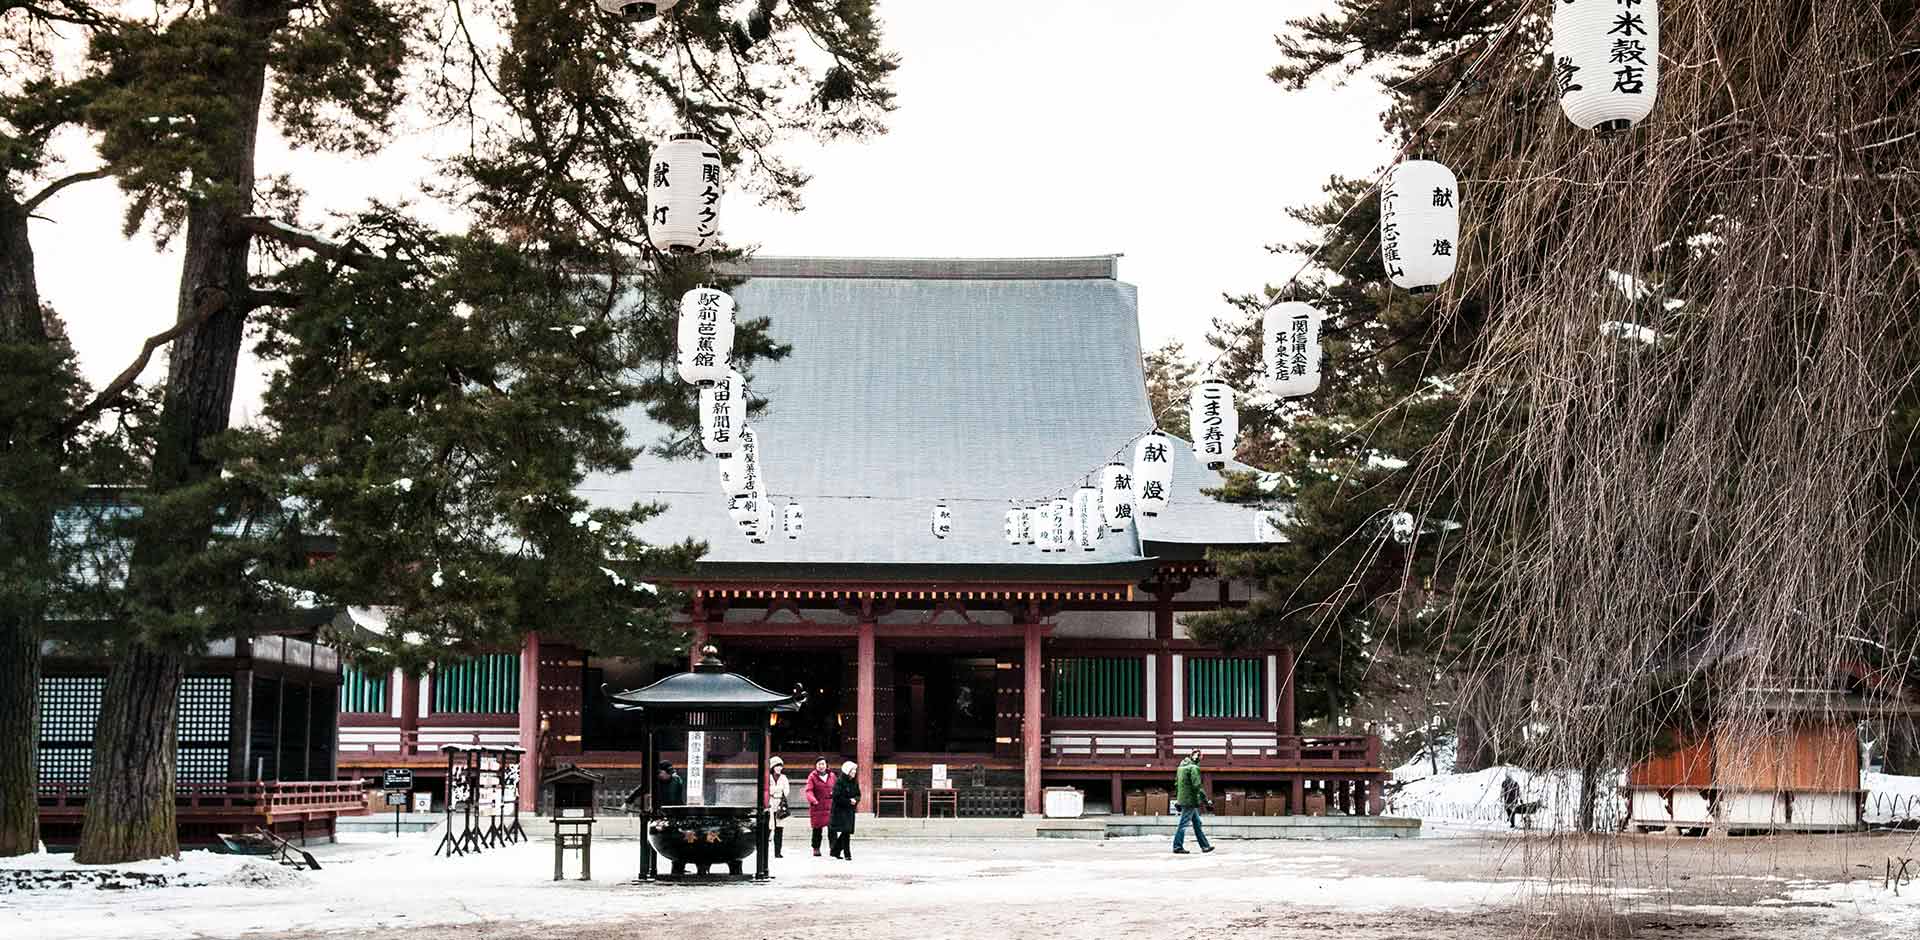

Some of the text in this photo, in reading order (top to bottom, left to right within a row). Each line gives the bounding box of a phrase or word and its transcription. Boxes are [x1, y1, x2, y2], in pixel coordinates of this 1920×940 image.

[698, 151, 722, 248] 一関タクシー
[1432, 186, 1454, 257] 献燈
[692, 292, 721, 368] 駅前芭蕉館
[1275, 331, 1290, 381] 平泉支店
[1290, 314, 1309, 377] 一関信用金庫
[1202, 388, 1225, 455] こまつ寿司
[1113, 473, 1132, 519] 献燈
[1142, 442, 1168, 501] 献燈
